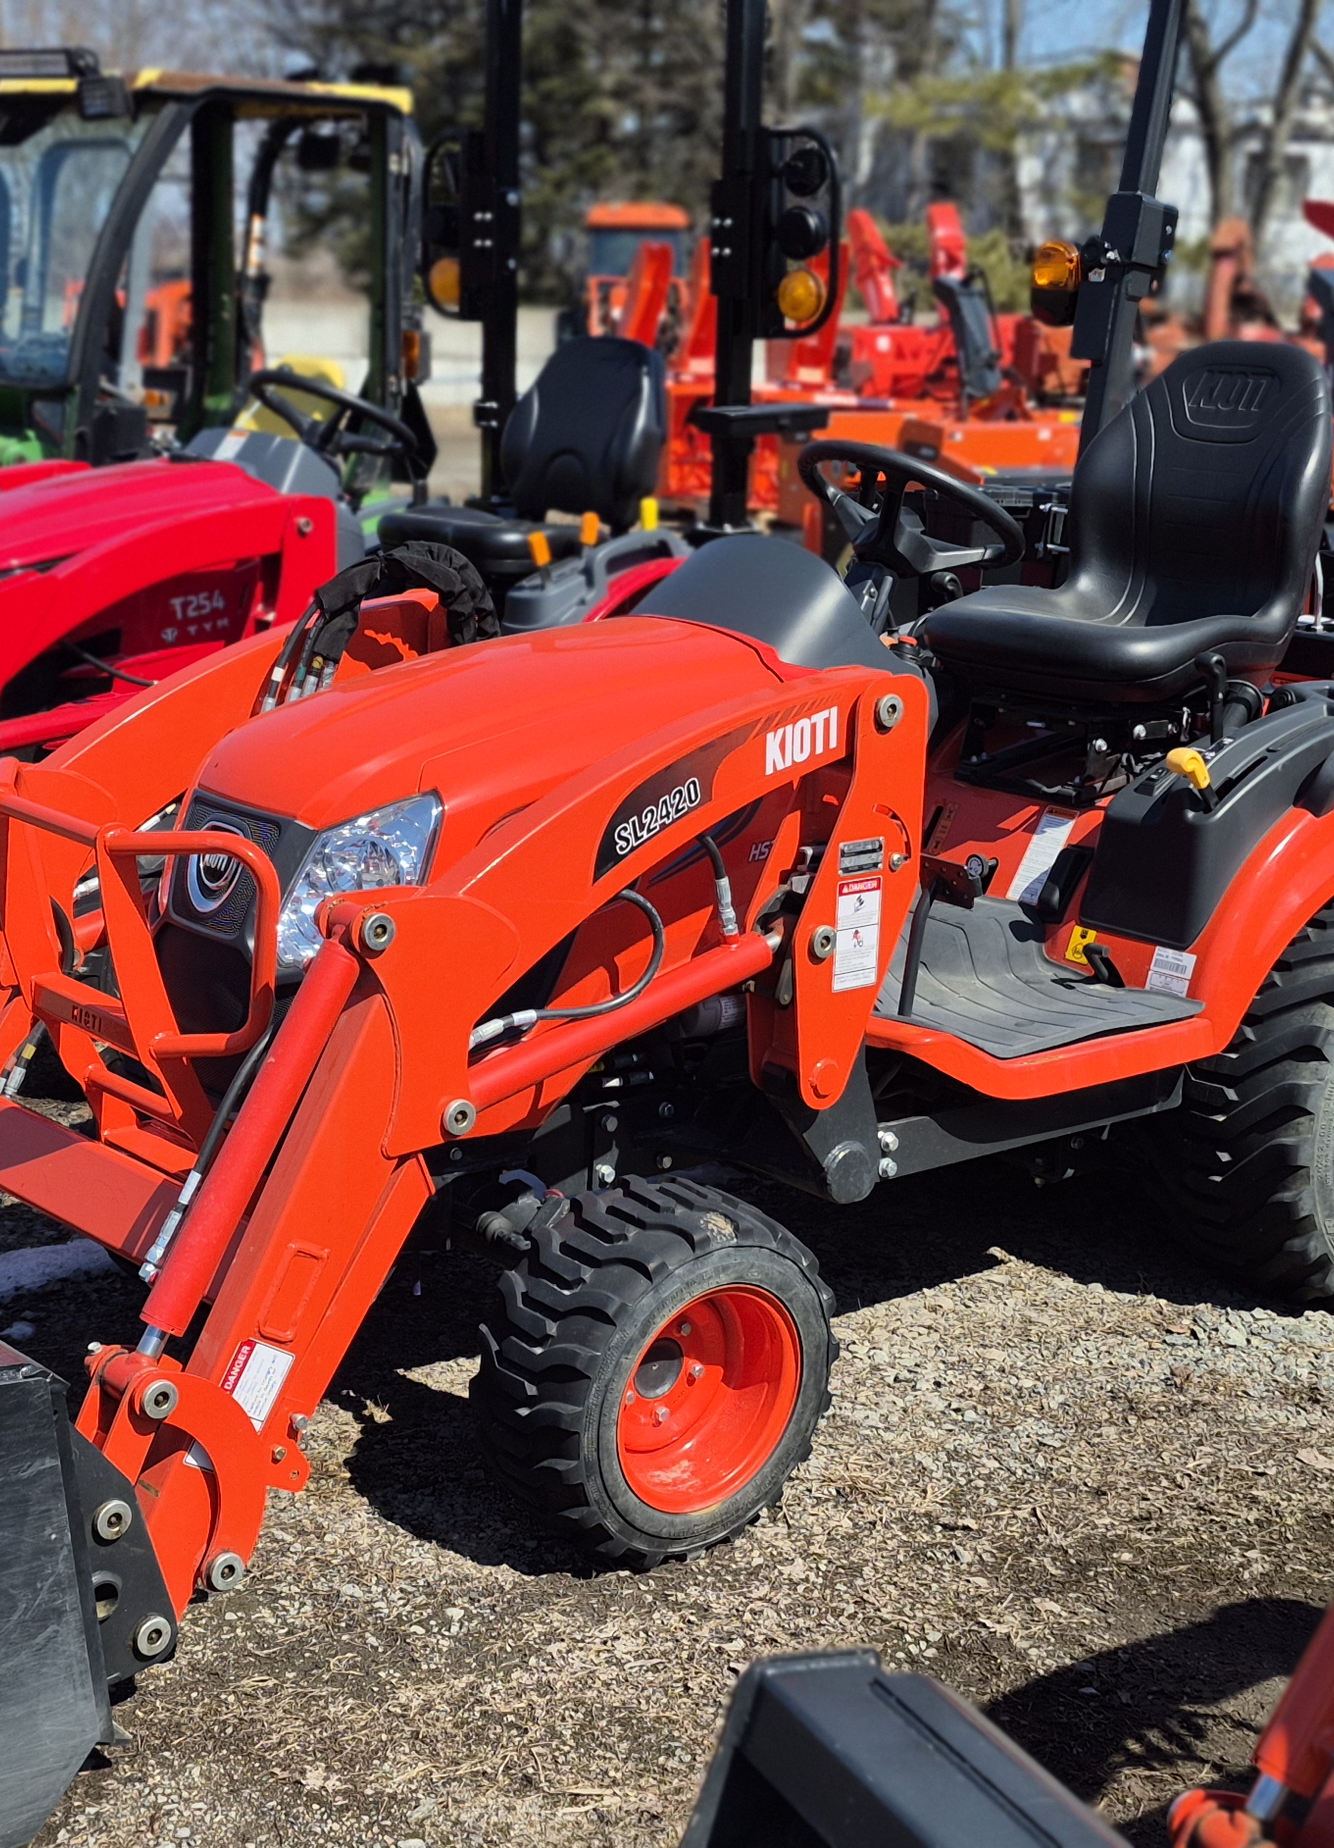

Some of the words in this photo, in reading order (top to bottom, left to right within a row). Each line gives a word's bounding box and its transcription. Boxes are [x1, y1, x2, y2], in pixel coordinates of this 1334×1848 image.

[170, 589, 225, 620] T254
[187, 617, 229, 636] TYM
[764, 705, 839, 776] KIOTI
[614, 777, 702, 856] SL2420
[748, 840, 774, 862] HS
[848, 880, 878, 893] DANGER
[223, 1344, 252, 1391] DANGER
